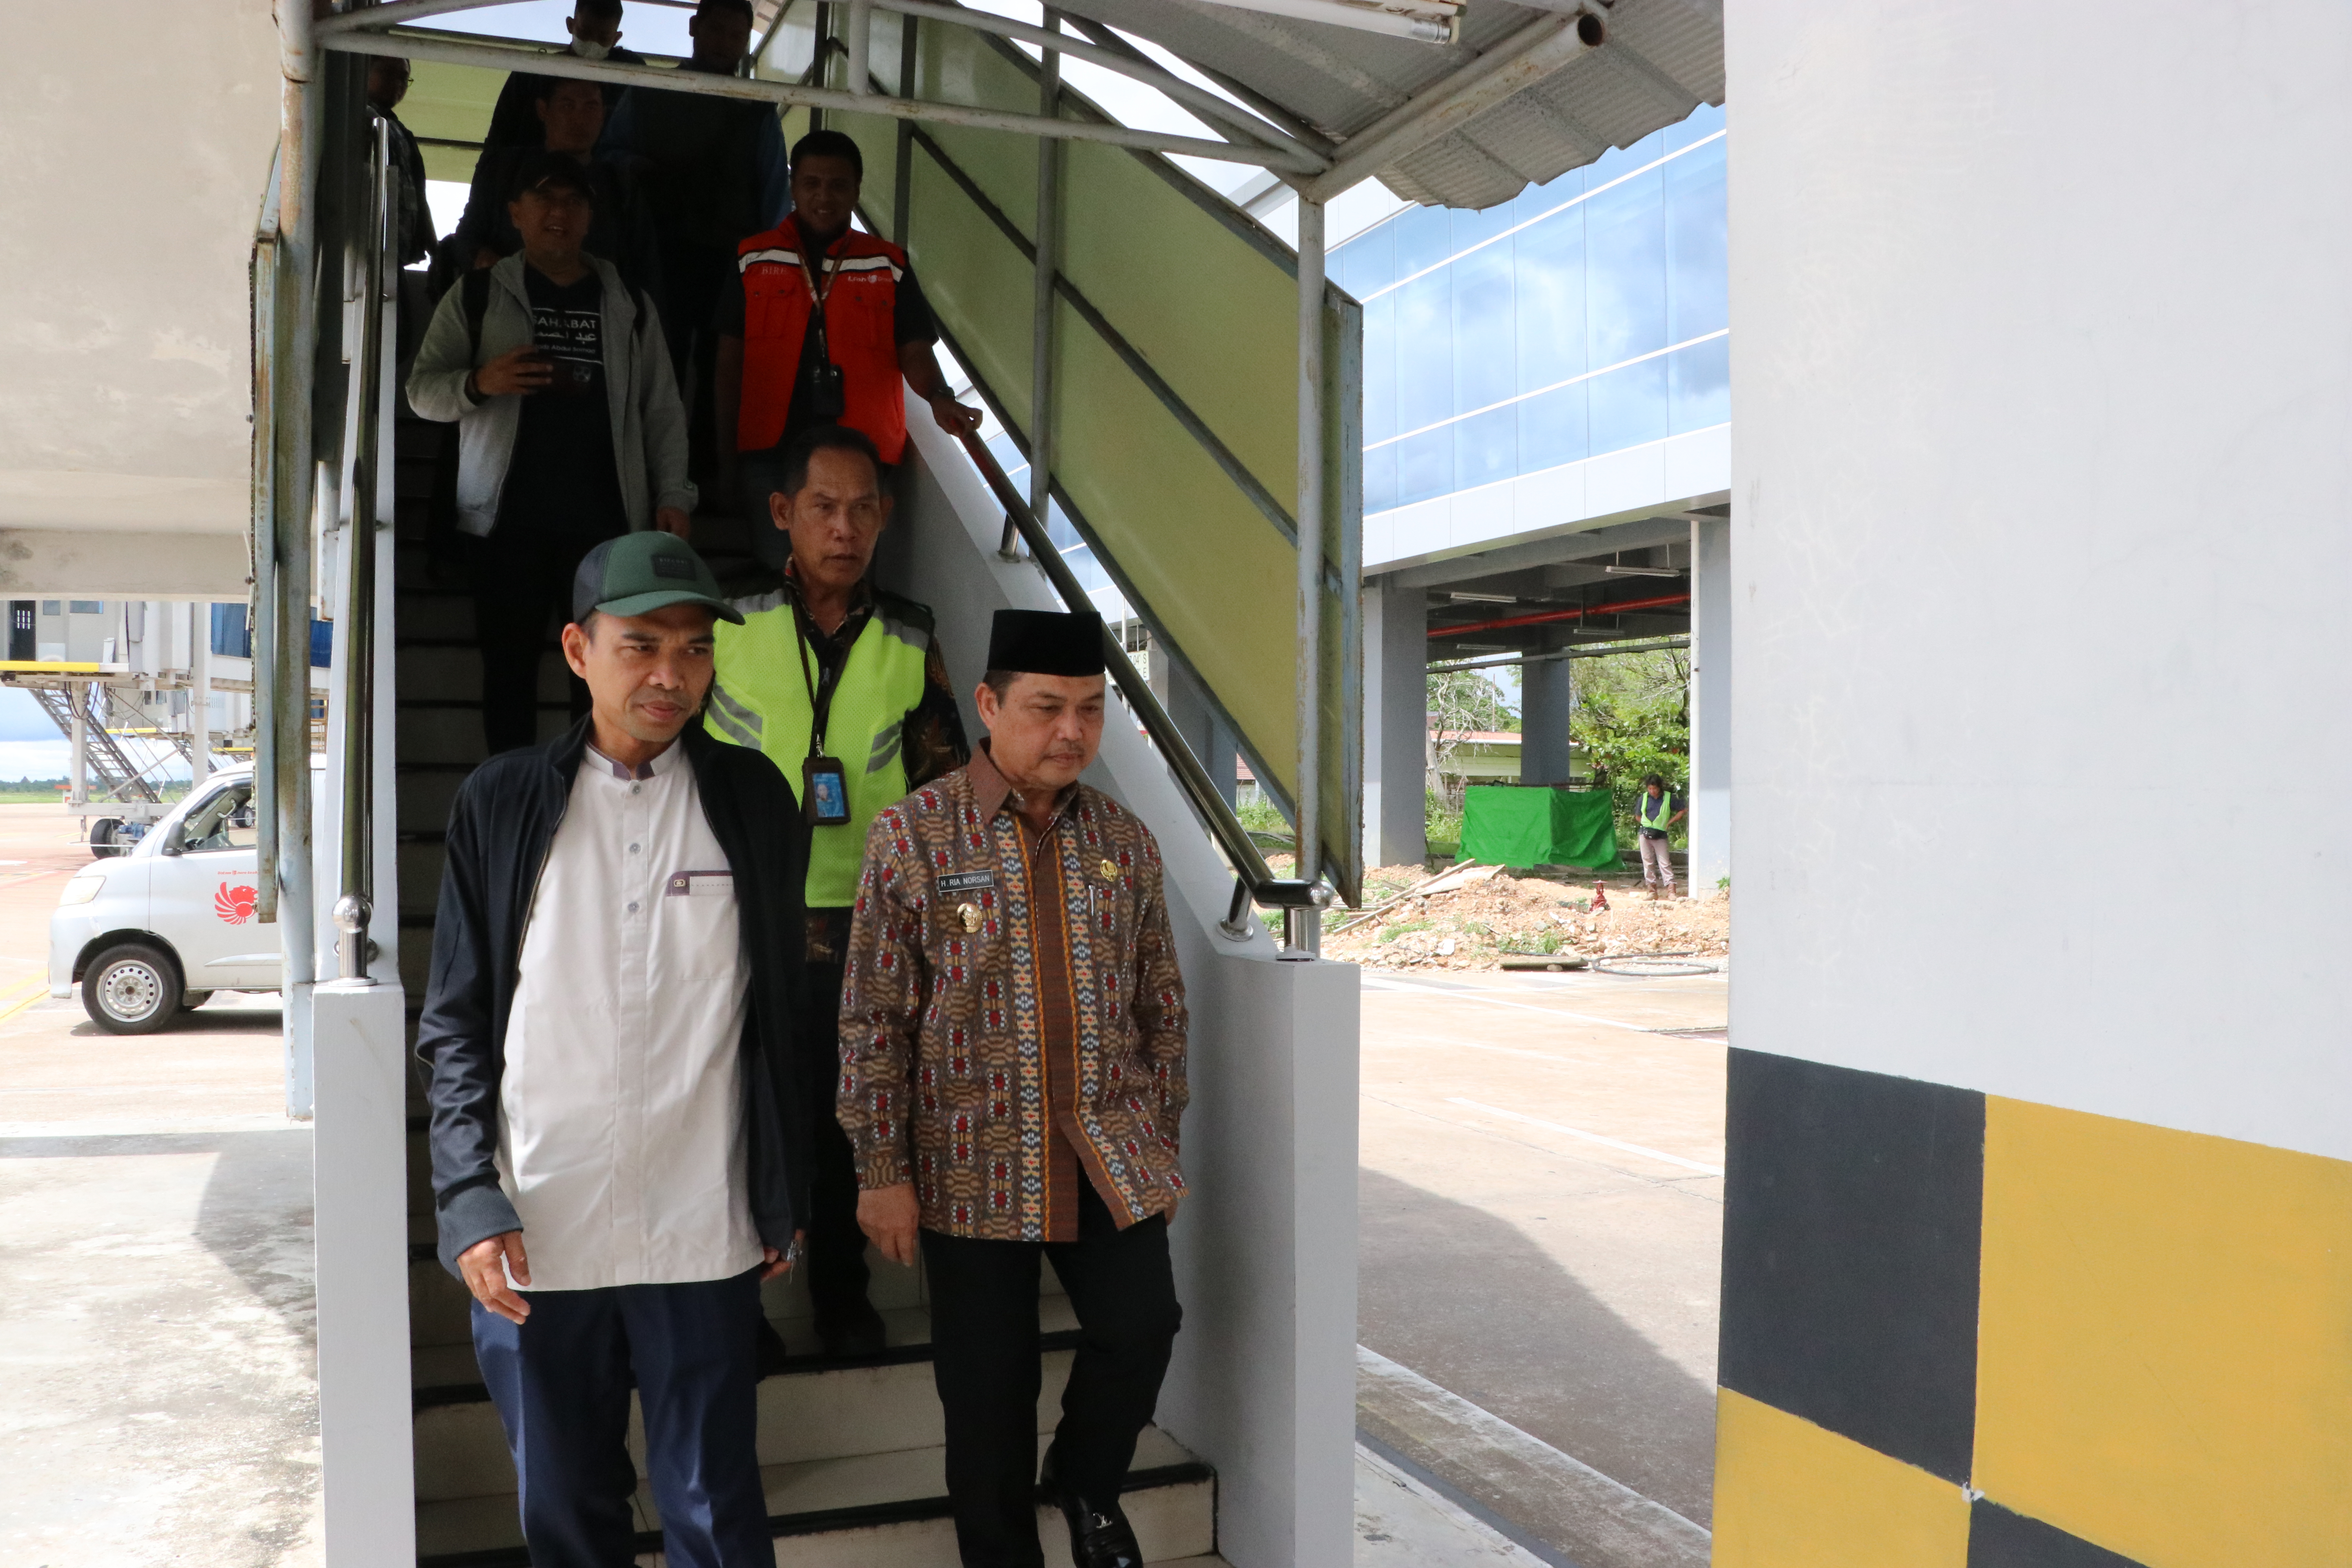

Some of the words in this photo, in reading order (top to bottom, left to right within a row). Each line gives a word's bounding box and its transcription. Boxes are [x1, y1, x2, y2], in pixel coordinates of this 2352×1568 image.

[1143, 653, 1147, 664] S
[1143, 667, 1147, 678] E
[963, 875, 989, 885] NORSAN
